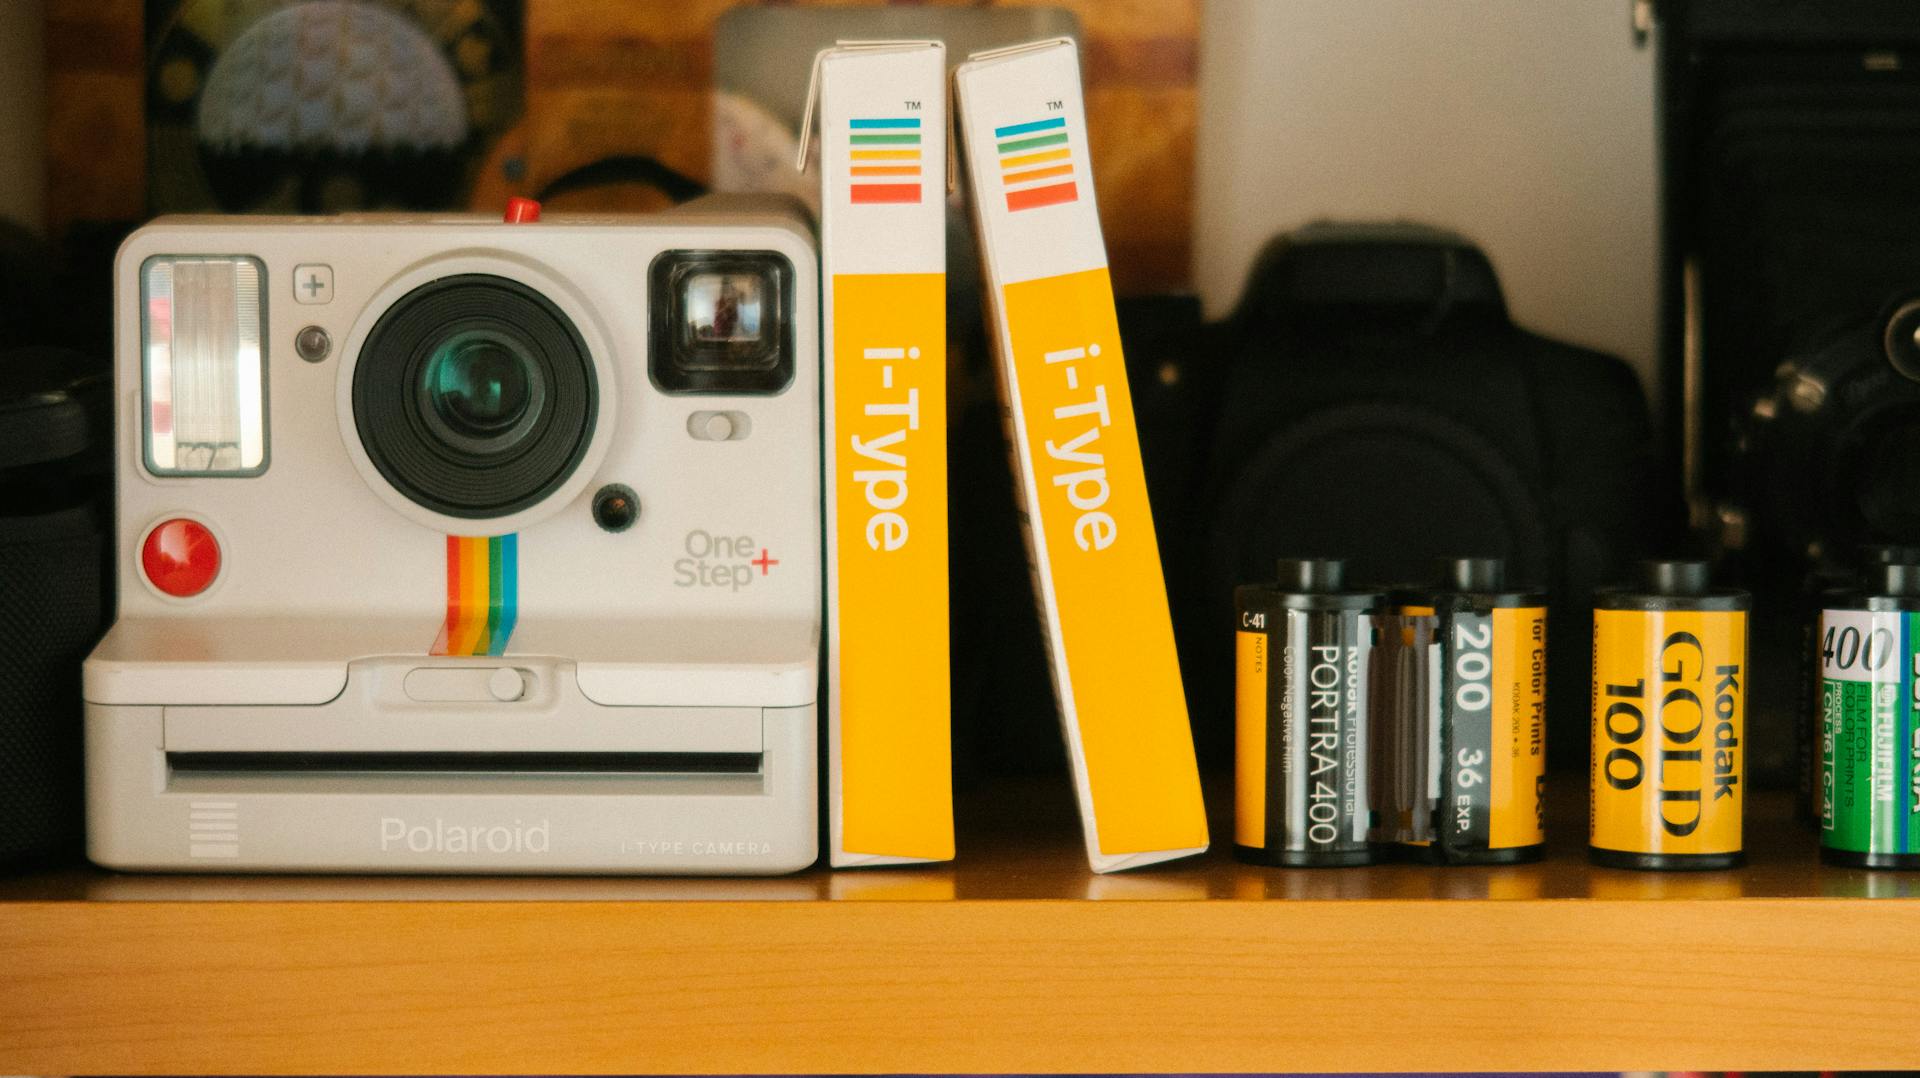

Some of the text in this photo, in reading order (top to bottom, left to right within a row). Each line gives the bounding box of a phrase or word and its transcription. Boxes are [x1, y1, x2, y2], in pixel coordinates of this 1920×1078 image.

[851, 347, 920, 551] i-Type
[1045, 344, 1117, 552] i-Type
[685, 529, 755, 558] One
[1243, 611, 1265, 628] C-41
[1255, 637, 1263, 673] NOTES
[1284, 646, 1296, 680] Color
[1823, 626, 1894, 672] 400
[1456, 623, 1491, 712] 200
[1530, 618, 1543, 756] for Color Prints
[1281, 685, 1296, 742] Negative
[1309, 646, 1340, 844] PORTRA 400
[1604, 679, 1646, 791] 100
[1659, 631, 1704, 837] GOLD
[1713, 664, 1739, 801] Kodak
[1823, 691, 1833, 821] CN-16 C-41
[1844, 682, 1855, 808] COLOR PRINTS
[1856, 683, 1867, 762] FILM FOR
[1877, 712, 1893, 801] FUJIFILM
[379, 816, 550, 854] Polaroid
[1456, 748, 1484, 834] 36 EXP.
[690, 841, 772, 856] CAMERA
